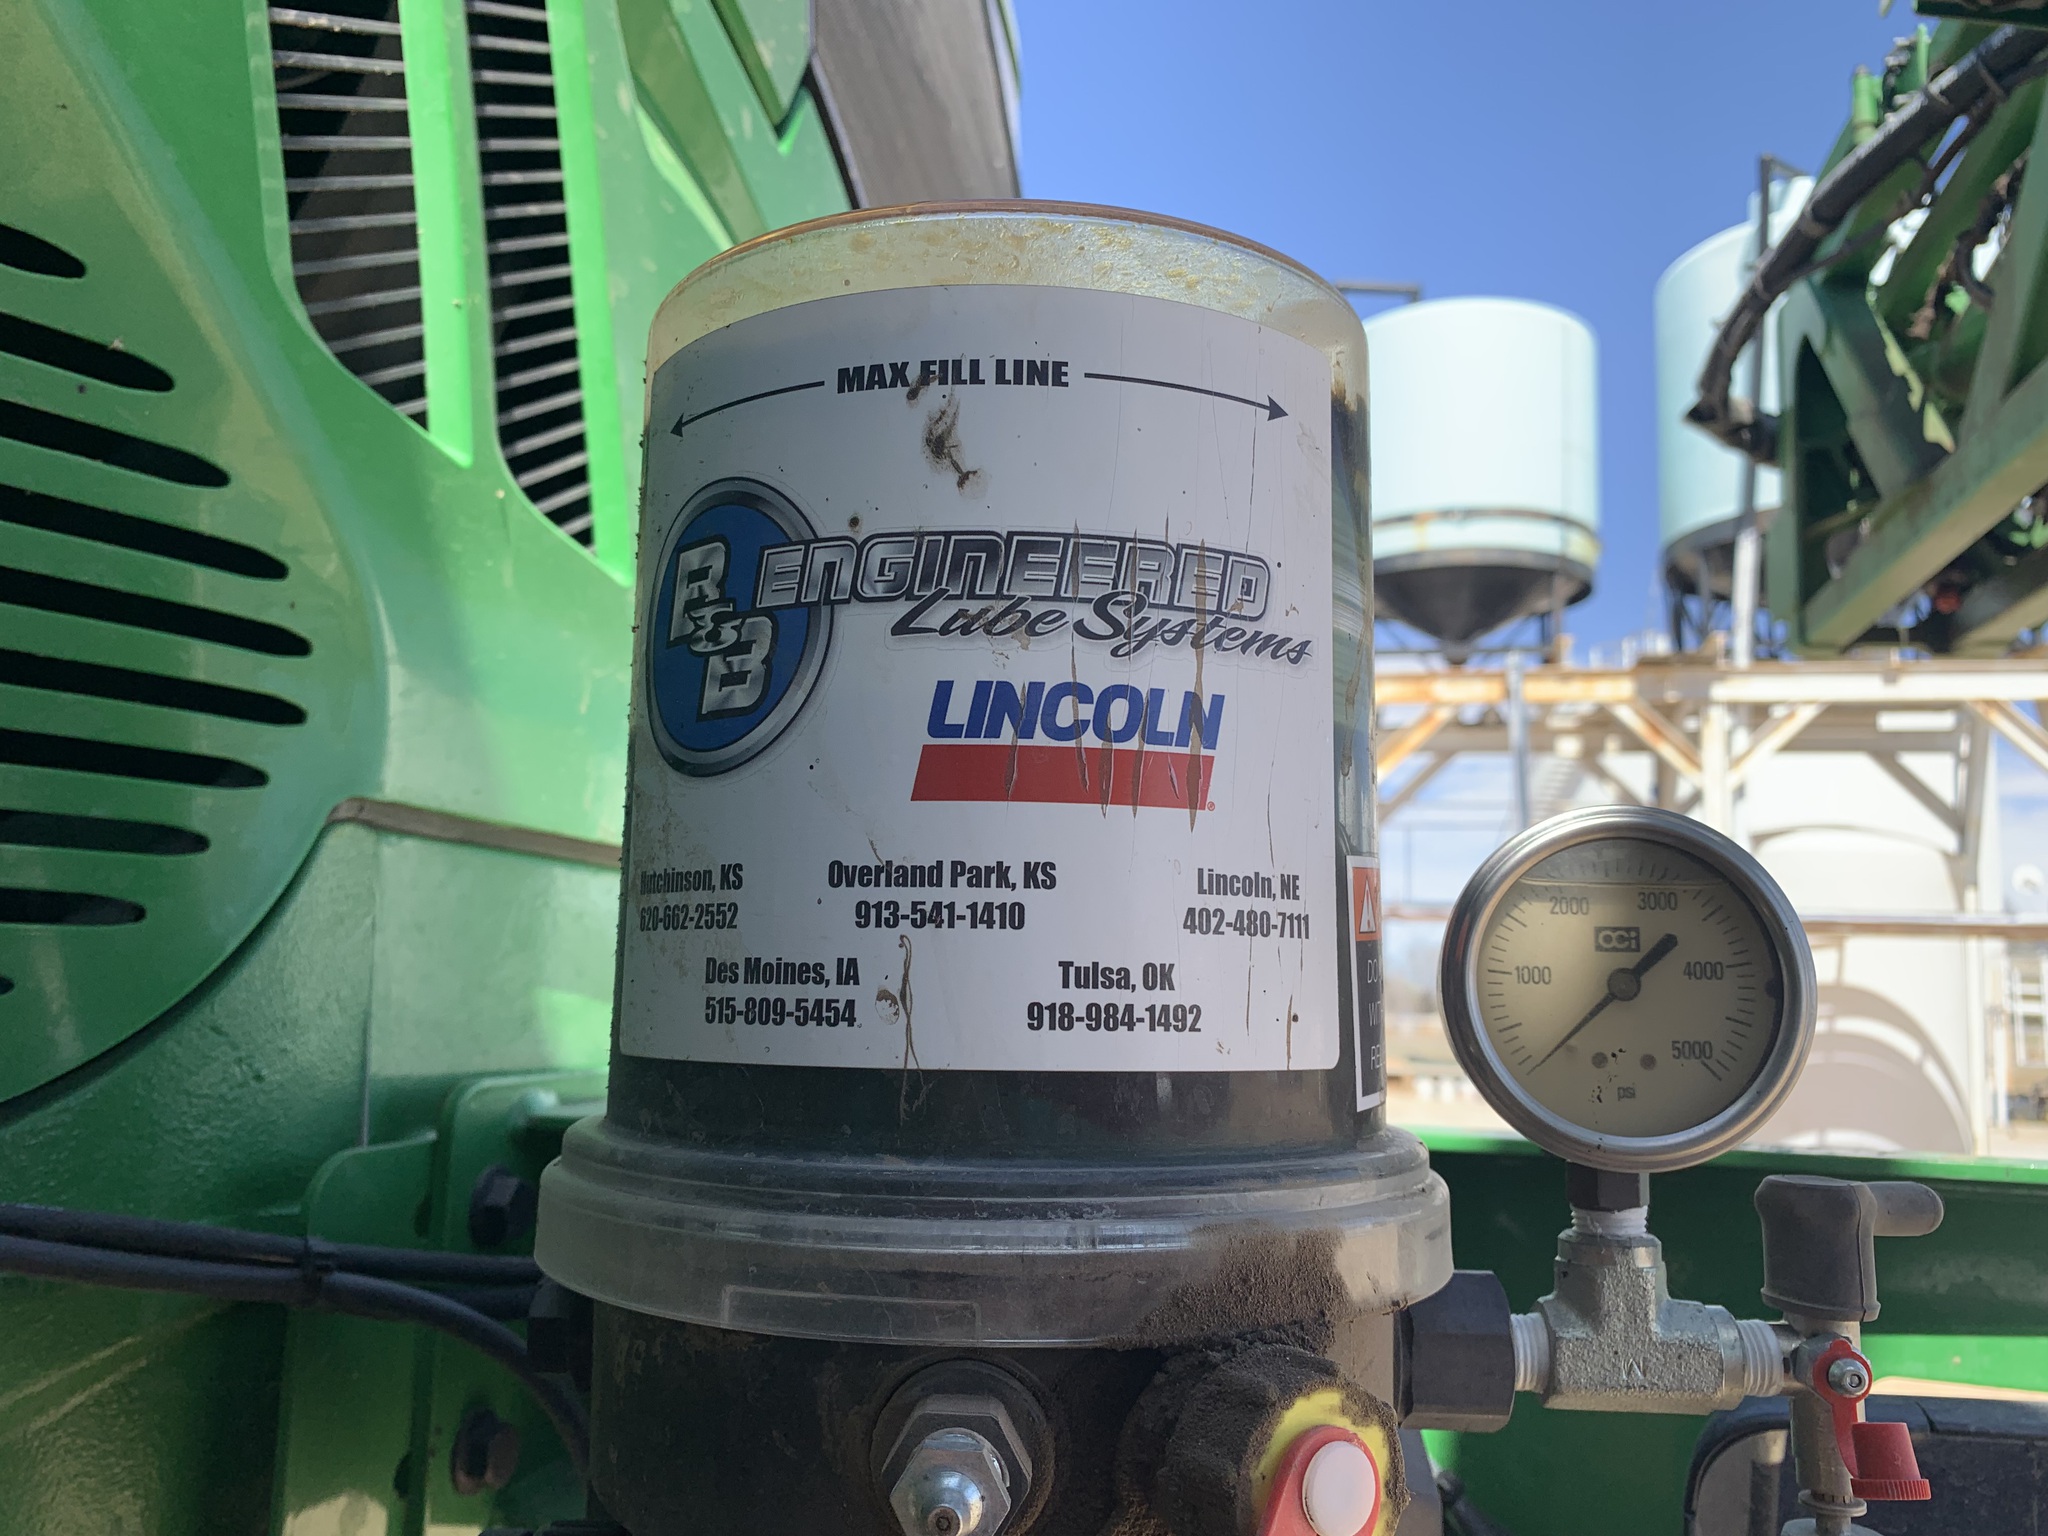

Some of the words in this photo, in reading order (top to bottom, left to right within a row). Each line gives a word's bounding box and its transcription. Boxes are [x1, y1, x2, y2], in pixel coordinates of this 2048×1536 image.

[837, 361, 910, 394] MAX
[920, 359, 986, 386] FILL
[995, 359, 1069, 387] LINE
[754, 531, 1270, 622] ENGINEERED
[890, 587, 1069, 637] Lube
[1073, 590, 1313, 665] Systems
[927, 680, 1226, 751] LINCOLN
[639, 867, 716, 896] Hutchinson,
[719, 862, 744, 891] KS
[828, 860, 944, 889] Overland
[950, 860, 1017, 892] Park,
[1023, 861, 1057, 890] KS
[1197, 868, 1277, 902] Lincoln,
[1280, 873, 1301, 901] NE
[639, 902, 739, 932] 620-662-2552
[855, 900, 1026, 930] 913-541-1410
[1550, 896, 1590, 915] 2000
[1638, 892, 1678, 911] 3000
[1183, 907, 1310, 940] 402-480-7111
[705, 957, 739, 985] Des
[743, 957, 830, 988] Moines,
[836, 957, 860, 986] IA
[1058, 961, 1136, 993] Tulsa,
[1142, 963, 1176, 991] OK
[1515, 965, 1551, 985] 1000
[1683, 961, 1724, 981] 4000
[705, 996, 857, 1028] 515-809-5454
[1027, 1002, 1202, 1032] 918-984-1492
[1672, 1040, 1713, 1060] 5000
[1617, 1085, 1637, 1101] psi
